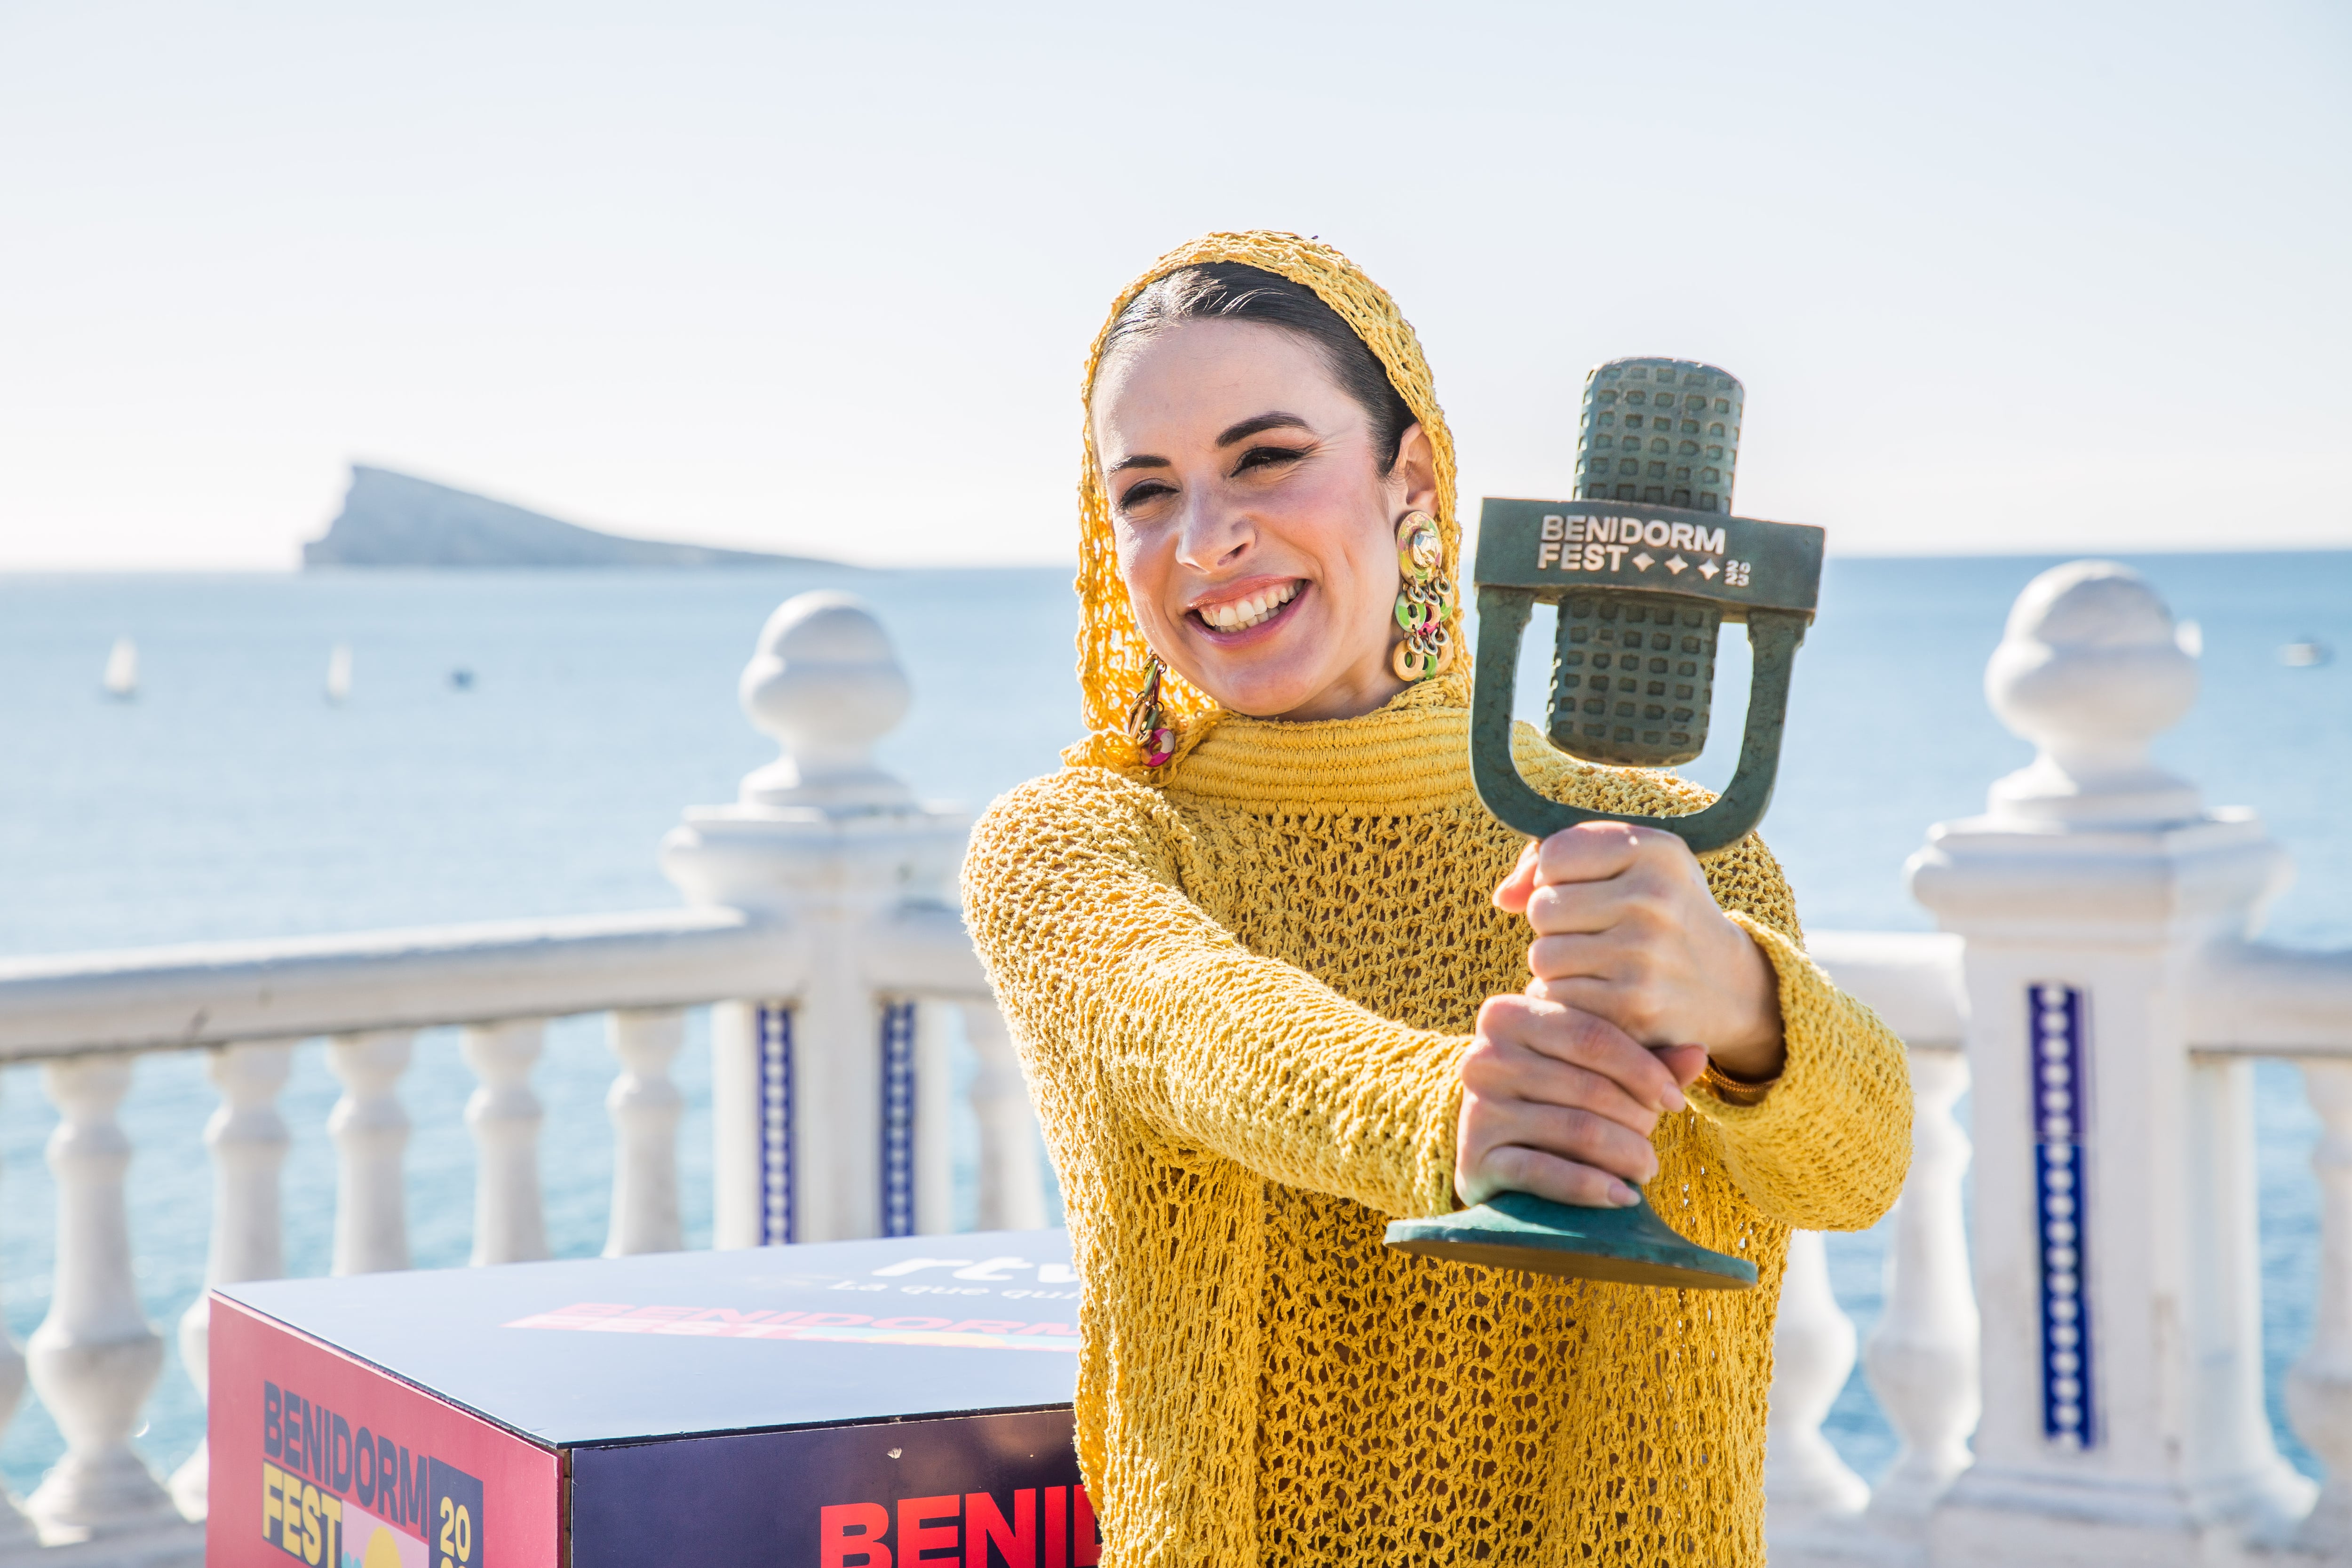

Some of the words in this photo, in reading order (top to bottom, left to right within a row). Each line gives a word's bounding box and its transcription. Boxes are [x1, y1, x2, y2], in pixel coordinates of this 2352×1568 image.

[1541, 515, 1726, 555] BENIDORM
[1537, 542, 1629, 572] FEST
[1725, 559, 1751, 573] 20
[900, 1285, 990, 1295] que
[1001, 1289, 1082, 1300] qui
[503, 1314, 810, 1338] FEST
[263, 1380, 427, 1538] BENIDORM
[262, 1460, 342, 1568] FEST
[440, 1496, 471, 1562] 20
